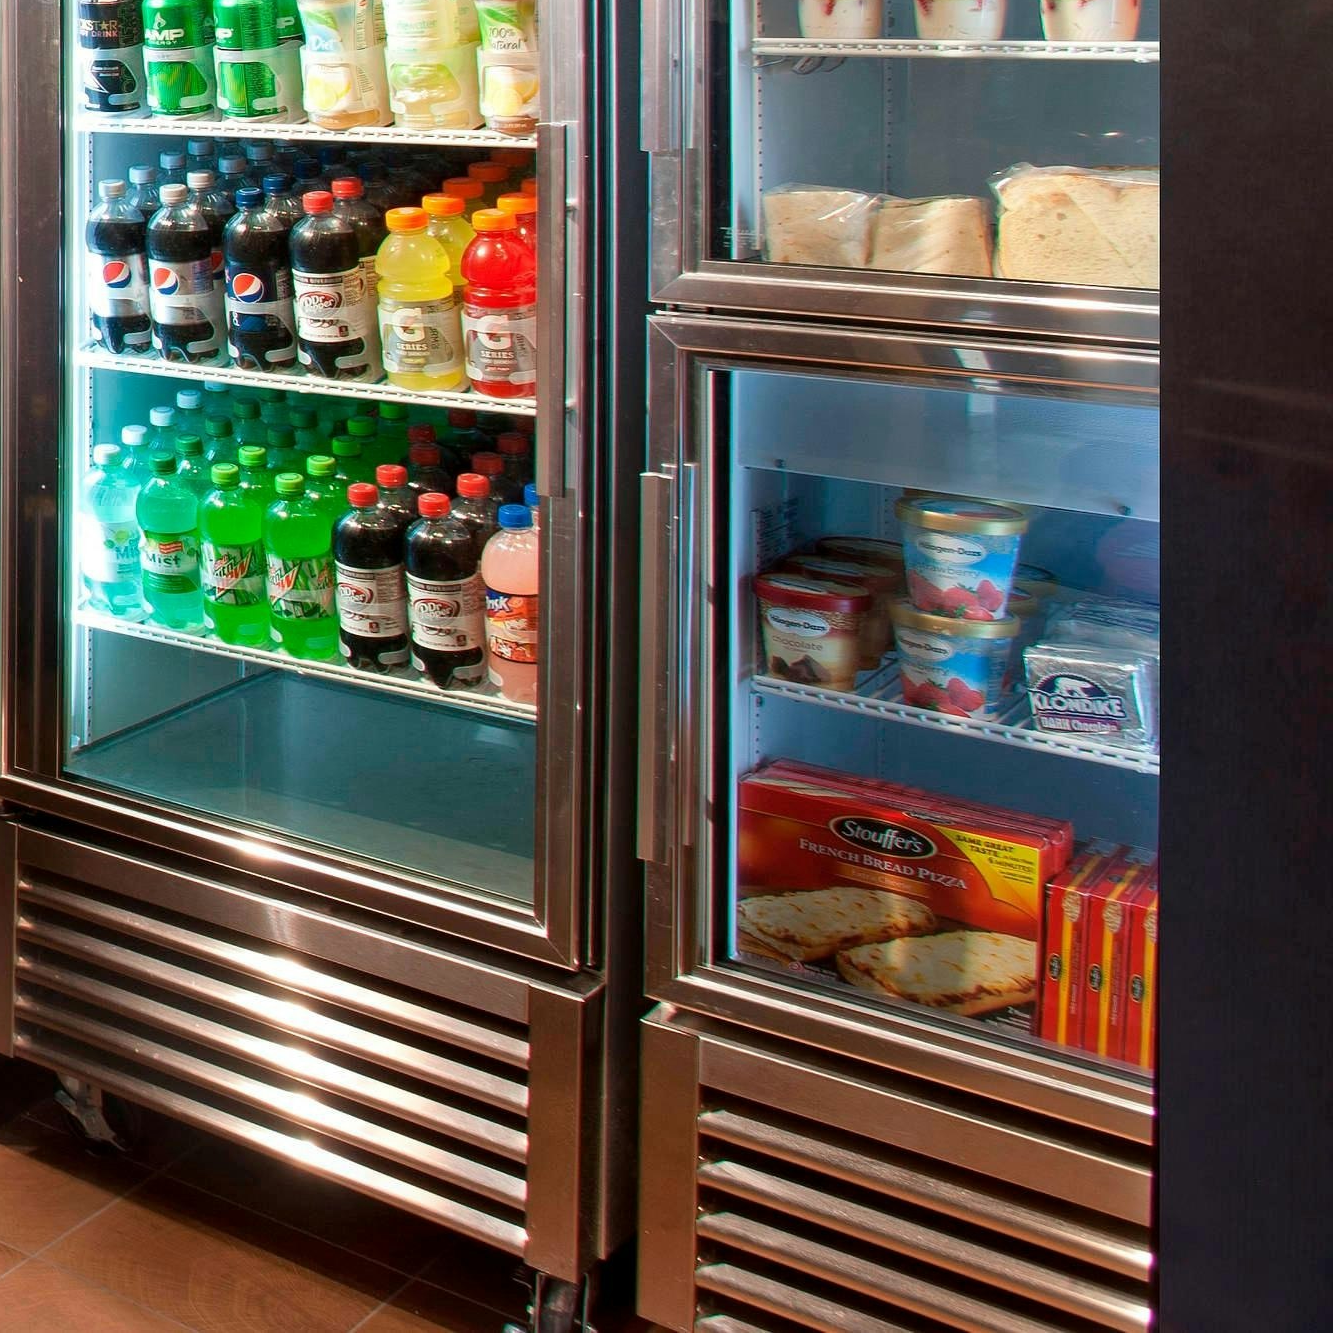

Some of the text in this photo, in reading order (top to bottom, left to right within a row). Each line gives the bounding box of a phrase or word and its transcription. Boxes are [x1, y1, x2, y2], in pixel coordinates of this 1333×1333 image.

[91, 29, 119, 39] DRINK
[489, 38, 522, 51] atural
[480, 350, 515, 359] SERIES
[146, 551, 182, 568] Mist
[772, 634, 824, 652] chocolate
[1028, 692, 1127, 718] KLONDIKE
[841, 819, 924, 854] Stouffer's
[954, 834, 1015, 853] SAME GREAT
[969, 845, 998, 858] TASTE
[799, 838, 969, 890] FRENCH BREAD PIZZA
